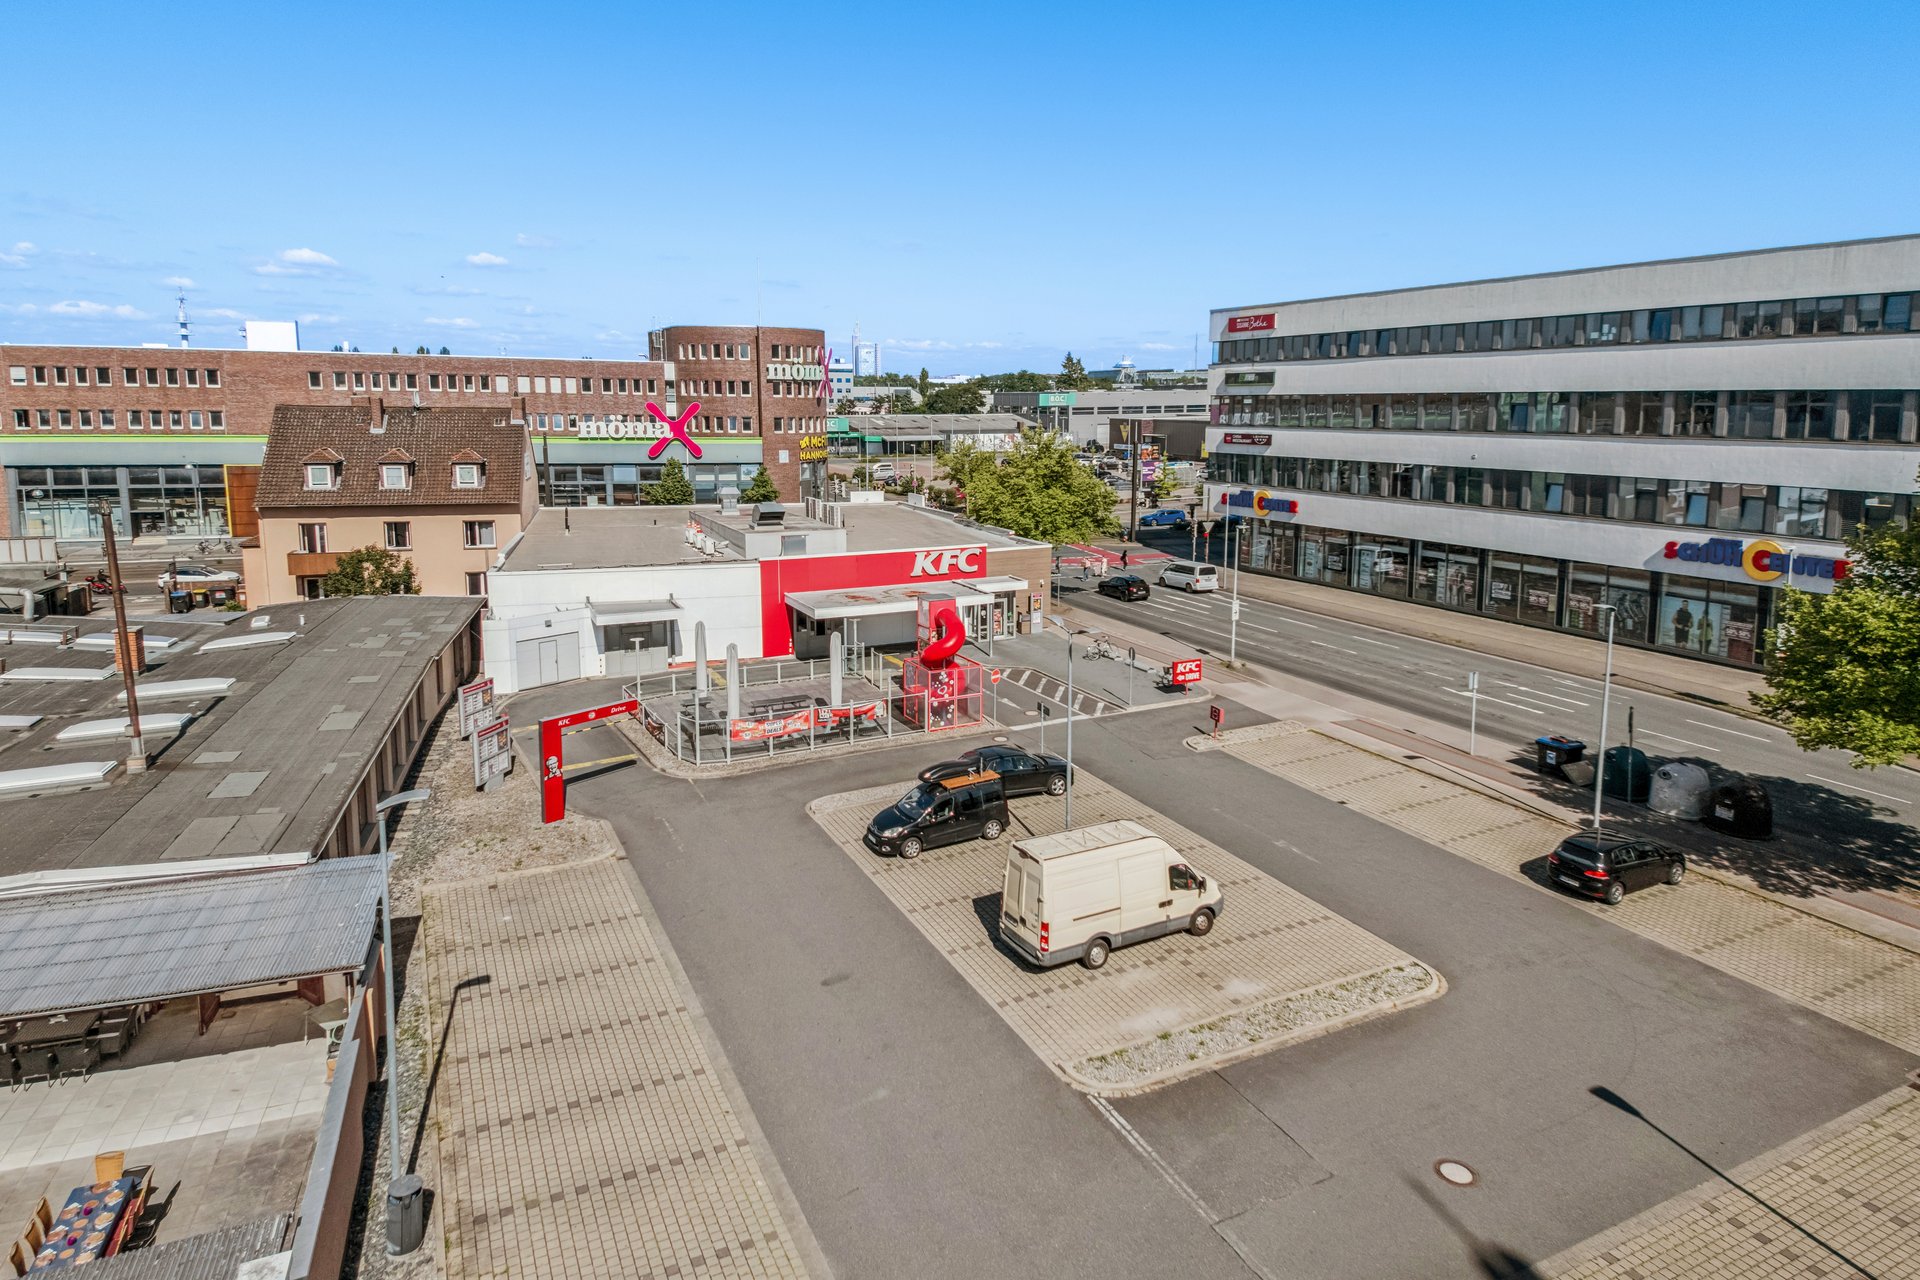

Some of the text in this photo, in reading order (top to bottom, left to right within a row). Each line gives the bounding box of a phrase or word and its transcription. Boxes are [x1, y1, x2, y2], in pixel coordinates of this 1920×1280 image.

[910, 548, 983, 577] KFC
[1176, 661, 1201, 673] KFC
[1185, 672, 1200, 680] DRIVE
[558, 718, 571, 726] KFC
[766, 727, 783, 735] DEALS
